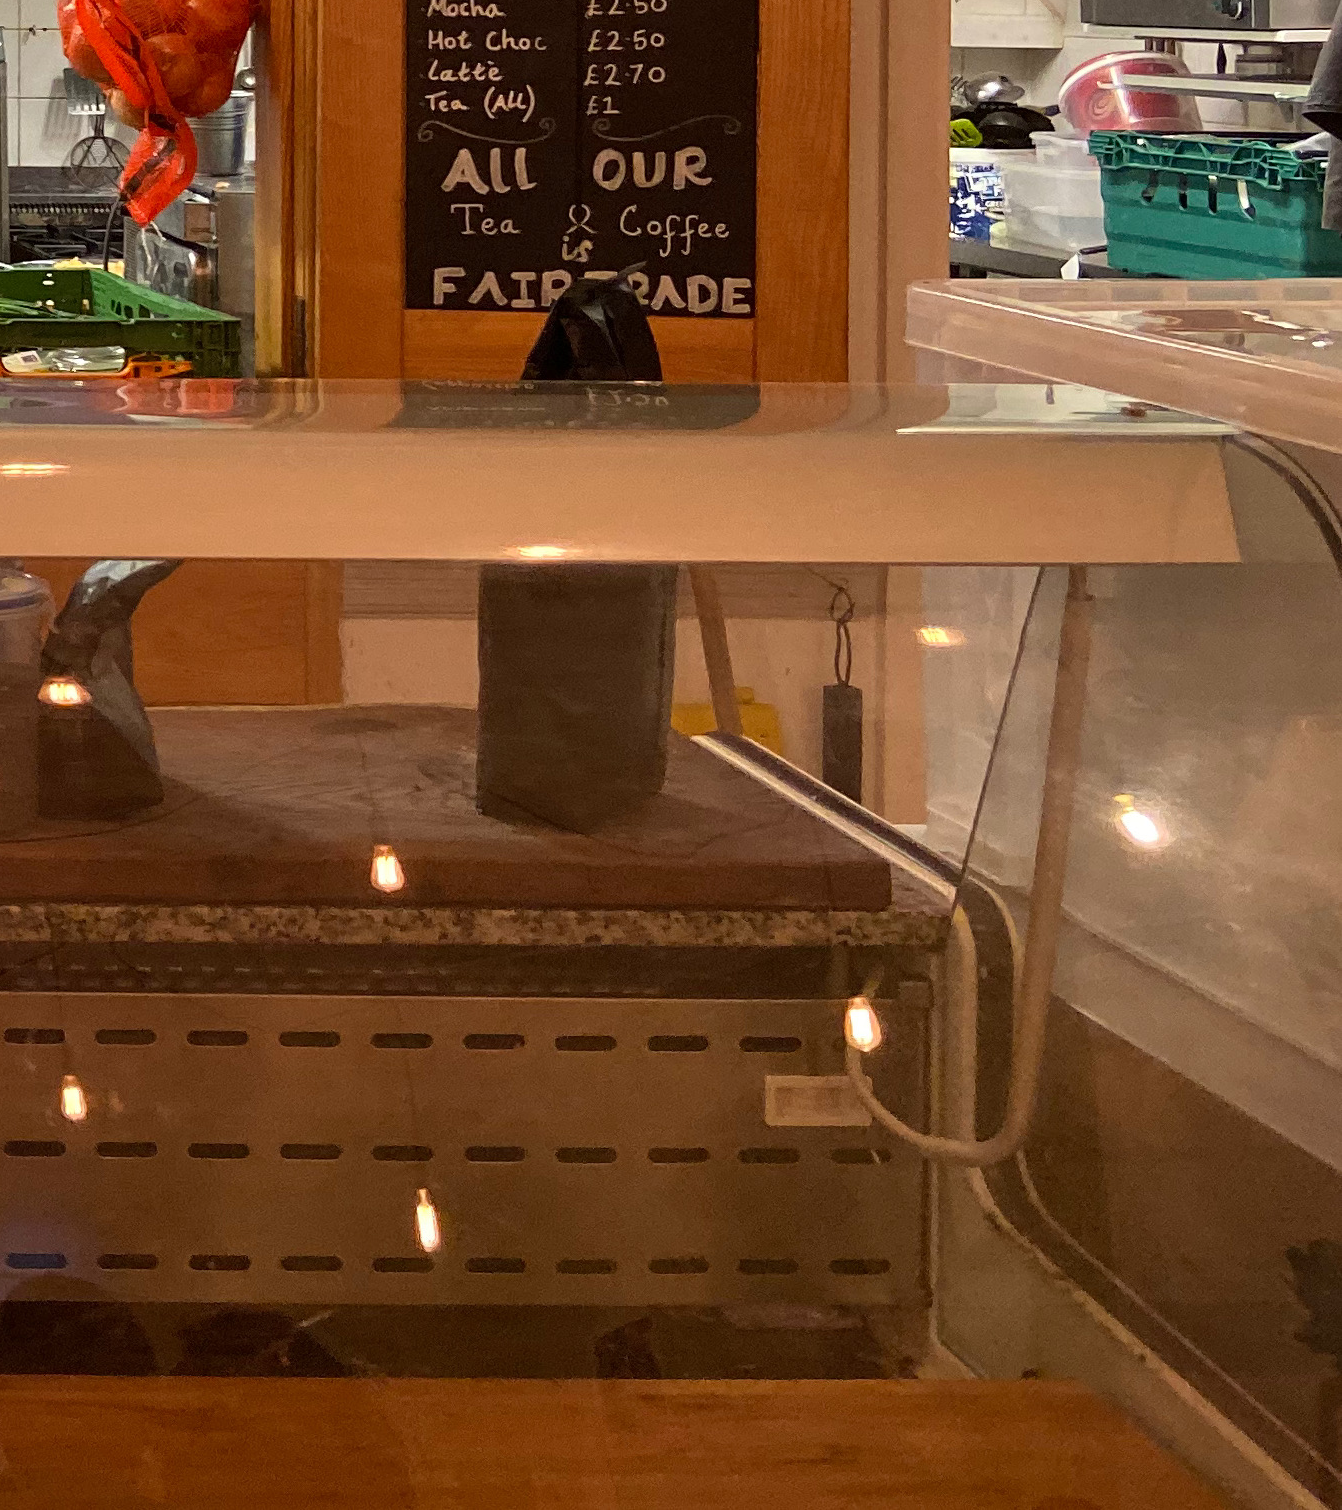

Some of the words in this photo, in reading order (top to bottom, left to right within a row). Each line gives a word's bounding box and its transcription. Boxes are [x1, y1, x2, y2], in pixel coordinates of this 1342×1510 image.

[427, 31, 473, 52] Hot
[485, 29, 548, 52] Choc
[424, 92, 469, 113] Tea
[585, 95, 621, 115] £1
[592, 146, 714, 190] OUR
[450, 203, 522, 236] Tea
[619, 204, 731, 258] Coffee
[561, 236, 594, 262] is
[432, 266, 753, 314] FAIRRADE
